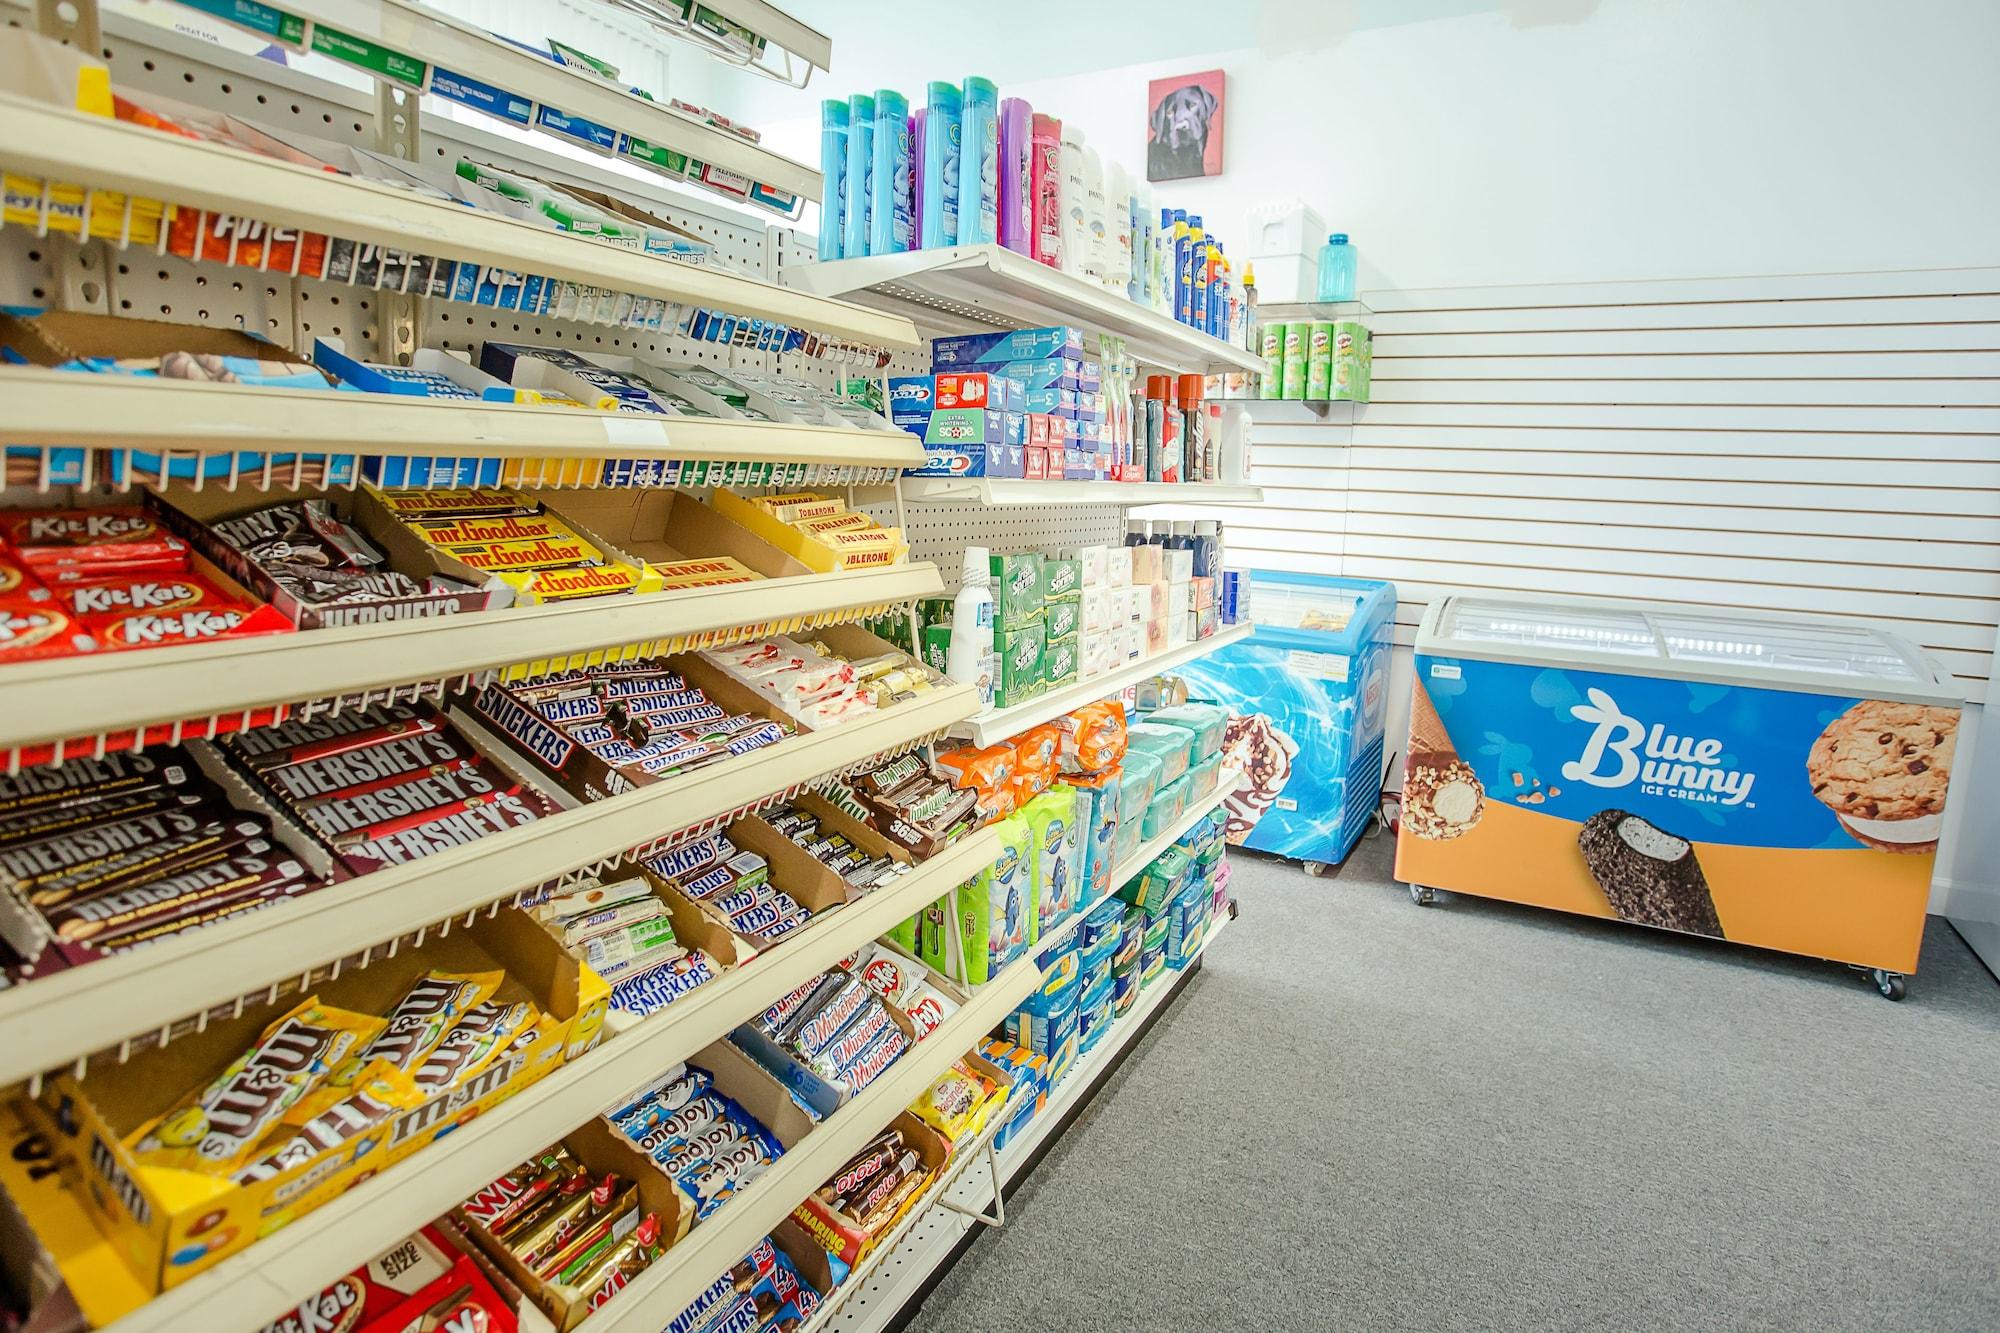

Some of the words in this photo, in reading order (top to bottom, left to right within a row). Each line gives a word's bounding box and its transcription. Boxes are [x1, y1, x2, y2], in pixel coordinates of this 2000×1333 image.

[565, 57, 597, 75] Trident
[810, 516, 863, 532] TOBLERONE
[654, 561, 735, 577] LERONE
[607, 675, 685, 699] SNICKERS
[629, 689, 705, 714] SNICKERS
[477, 685, 573, 769] SNICKERS
[651, 703, 723, 729] SNICKERS
[1562, 688, 1723, 788] Blue
[276, 731, 459, 799] HERSHEY'S
[306, 764, 494, 837] HERSHEY'S
[1640, 784, 1664, 796] ICE
[1668, 788, 1718, 803] CREAM
[889, 819, 911, 839] 36
[934, 1078, 969, 1115] Raisinets
[794, 1204, 847, 1251] SHARING
[378, 1241, 416, 1270] KING
[385, 1252, 423, 1282] SIZE
